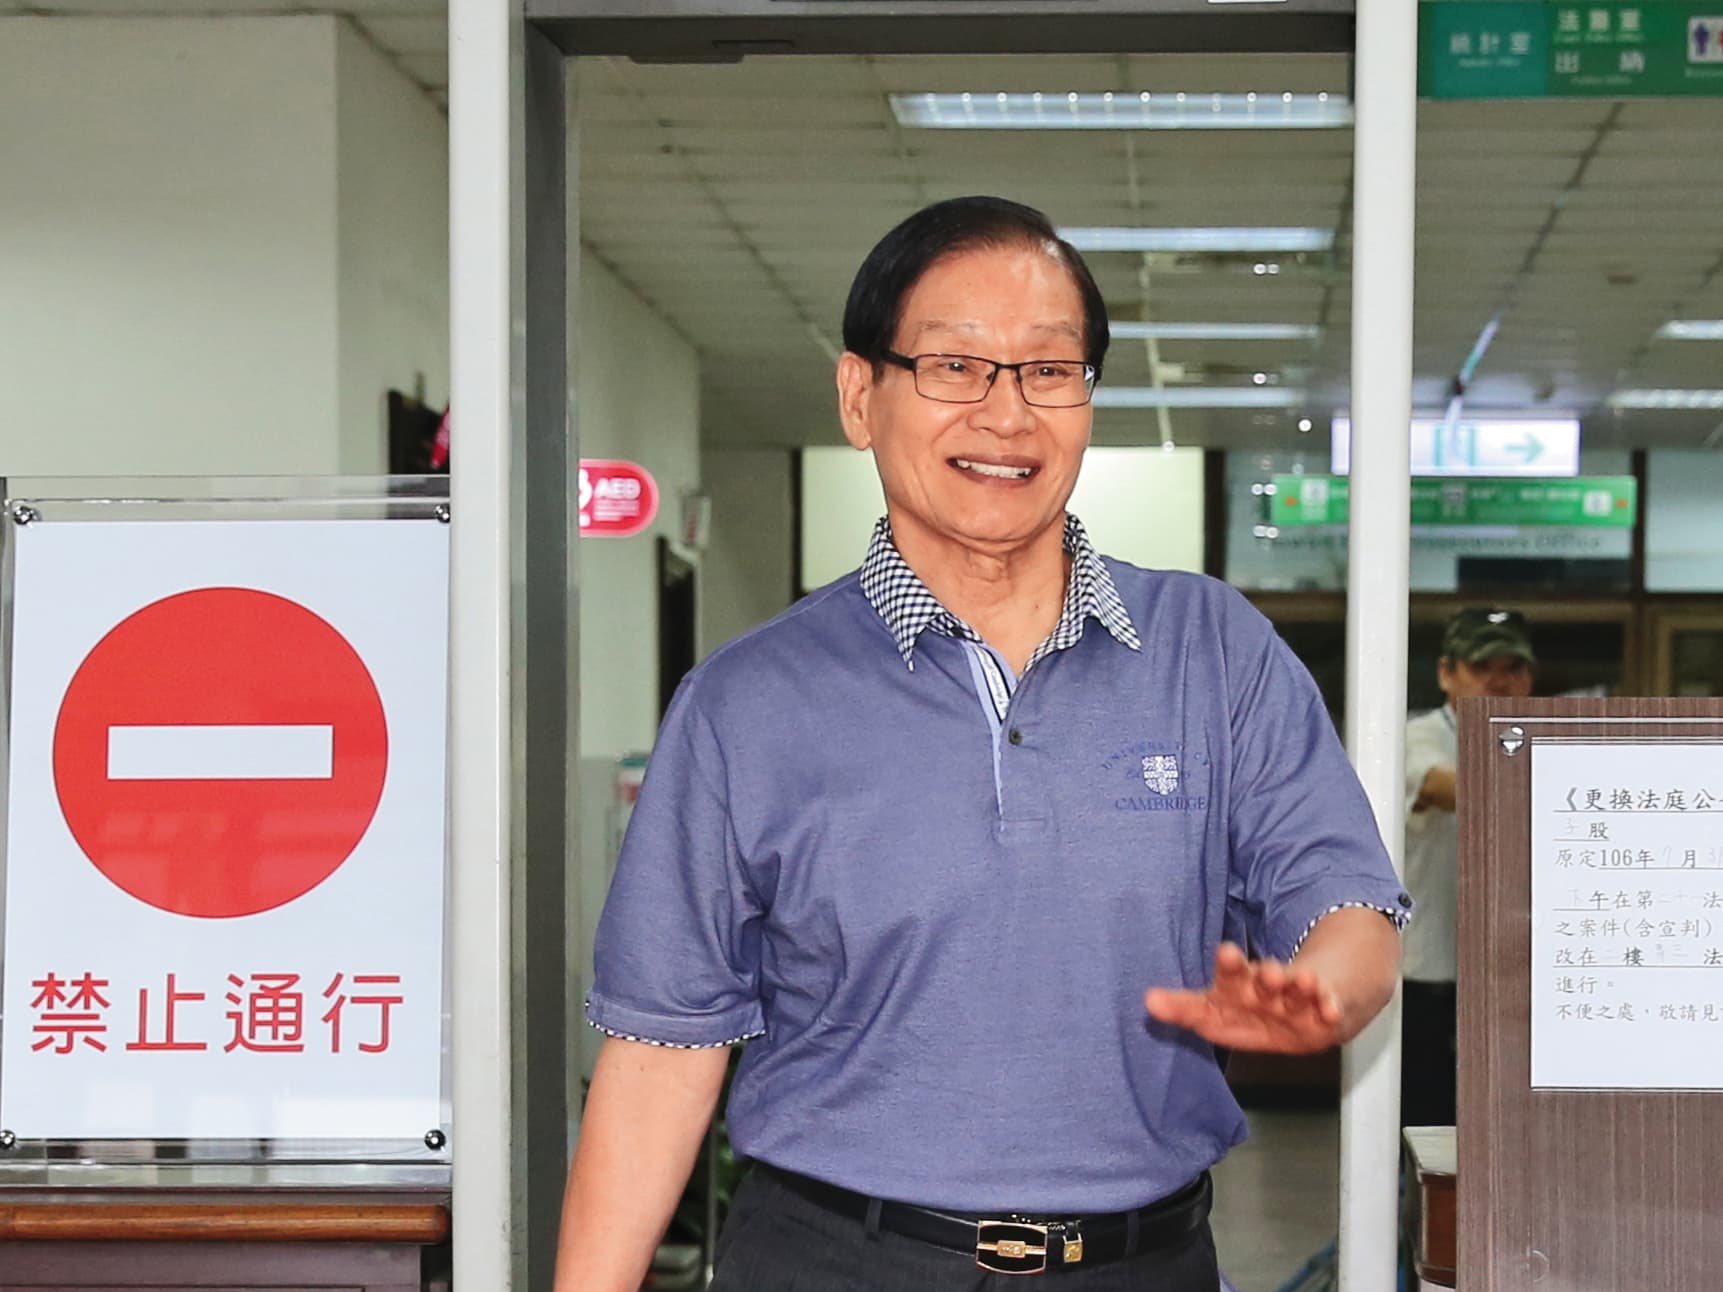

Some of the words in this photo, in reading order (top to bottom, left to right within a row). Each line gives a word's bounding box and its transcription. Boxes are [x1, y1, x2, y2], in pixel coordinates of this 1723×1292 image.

[1114, 796, 1208, 811] CAMBRIDGE
[1566, 786, 1723, 811] 《更換法庭公
[30, 972, 404, 1055] 禁止通行
[1556, 1002, 1723, 1021] 不便之處，敬請見
